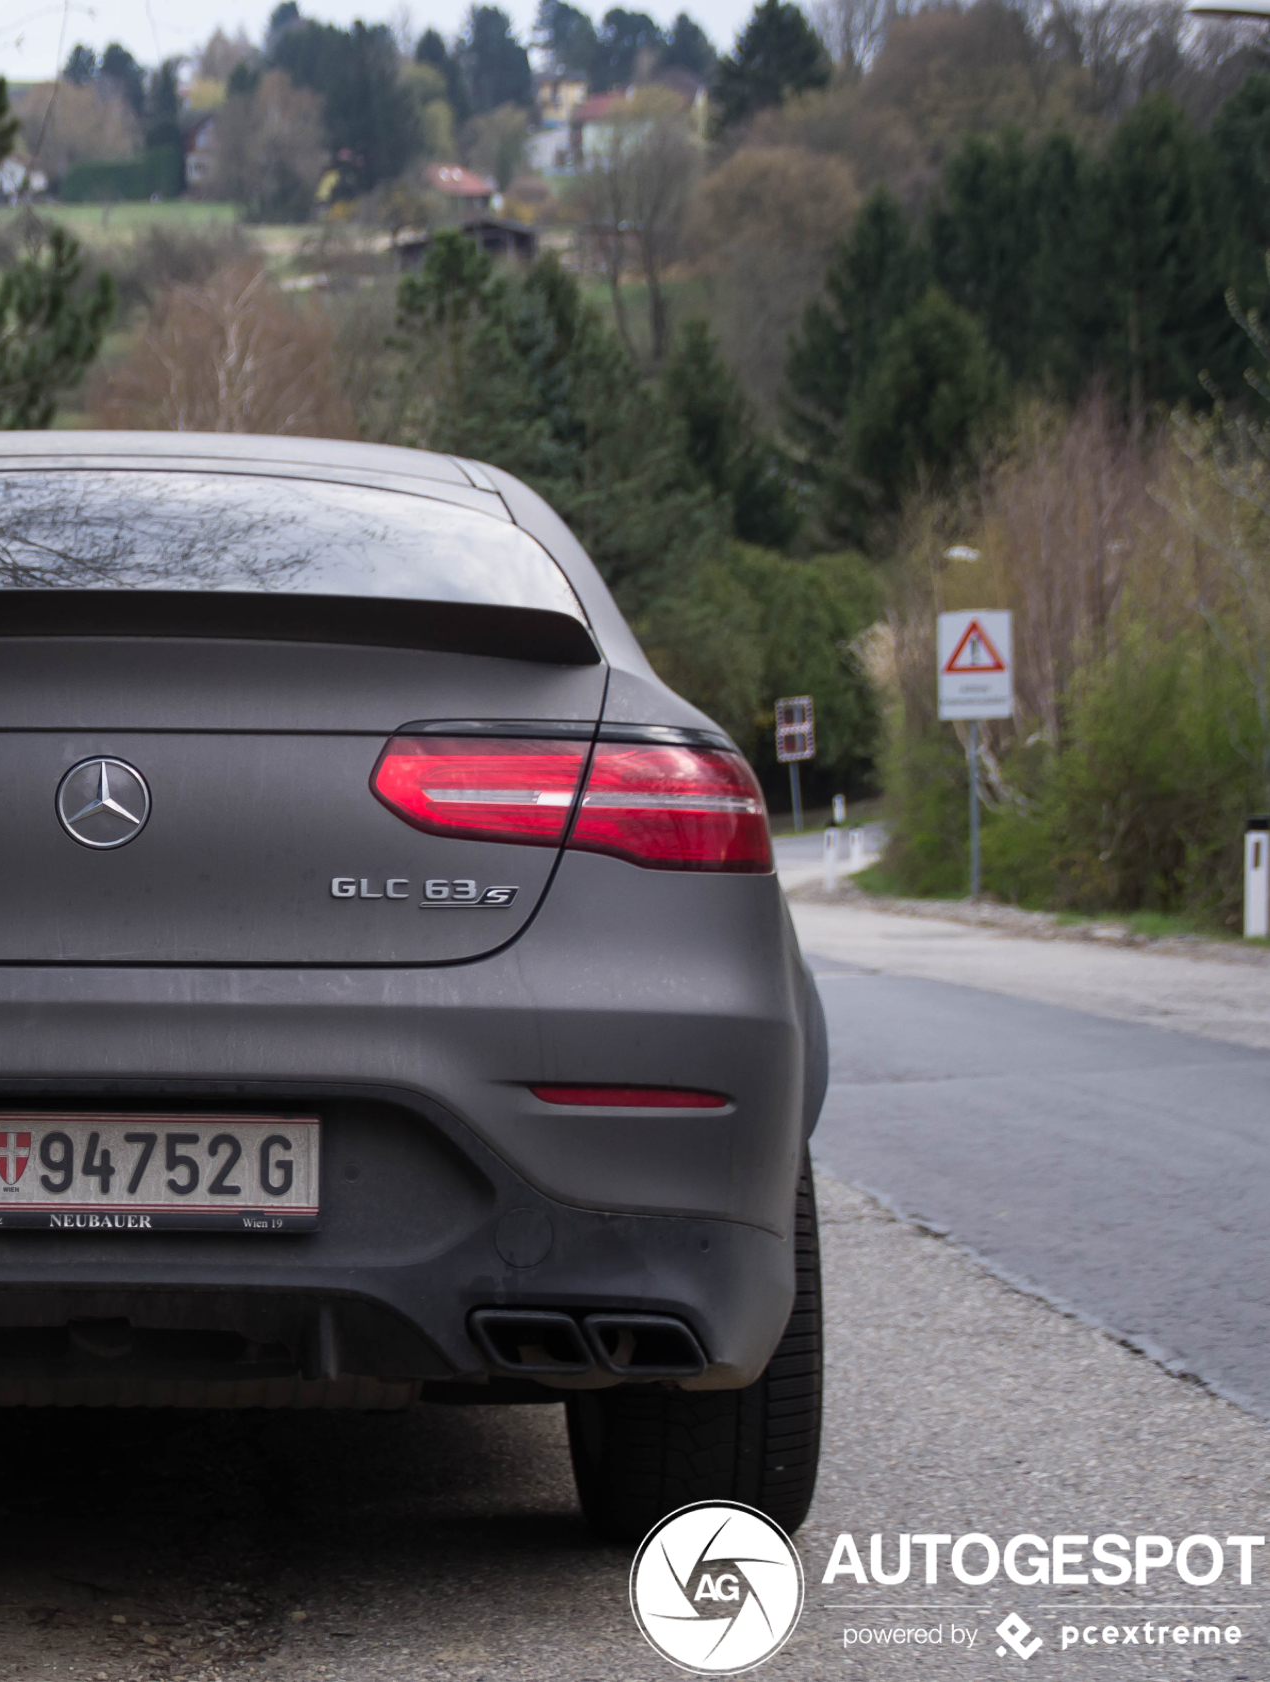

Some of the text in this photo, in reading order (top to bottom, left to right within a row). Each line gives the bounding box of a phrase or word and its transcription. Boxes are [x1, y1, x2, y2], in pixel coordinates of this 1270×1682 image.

[332, 877, 410, 899] GLC
[49, 1213, 152, 1229] NEUBAUER
[242, 1217, 283, 1229] Wien 19
